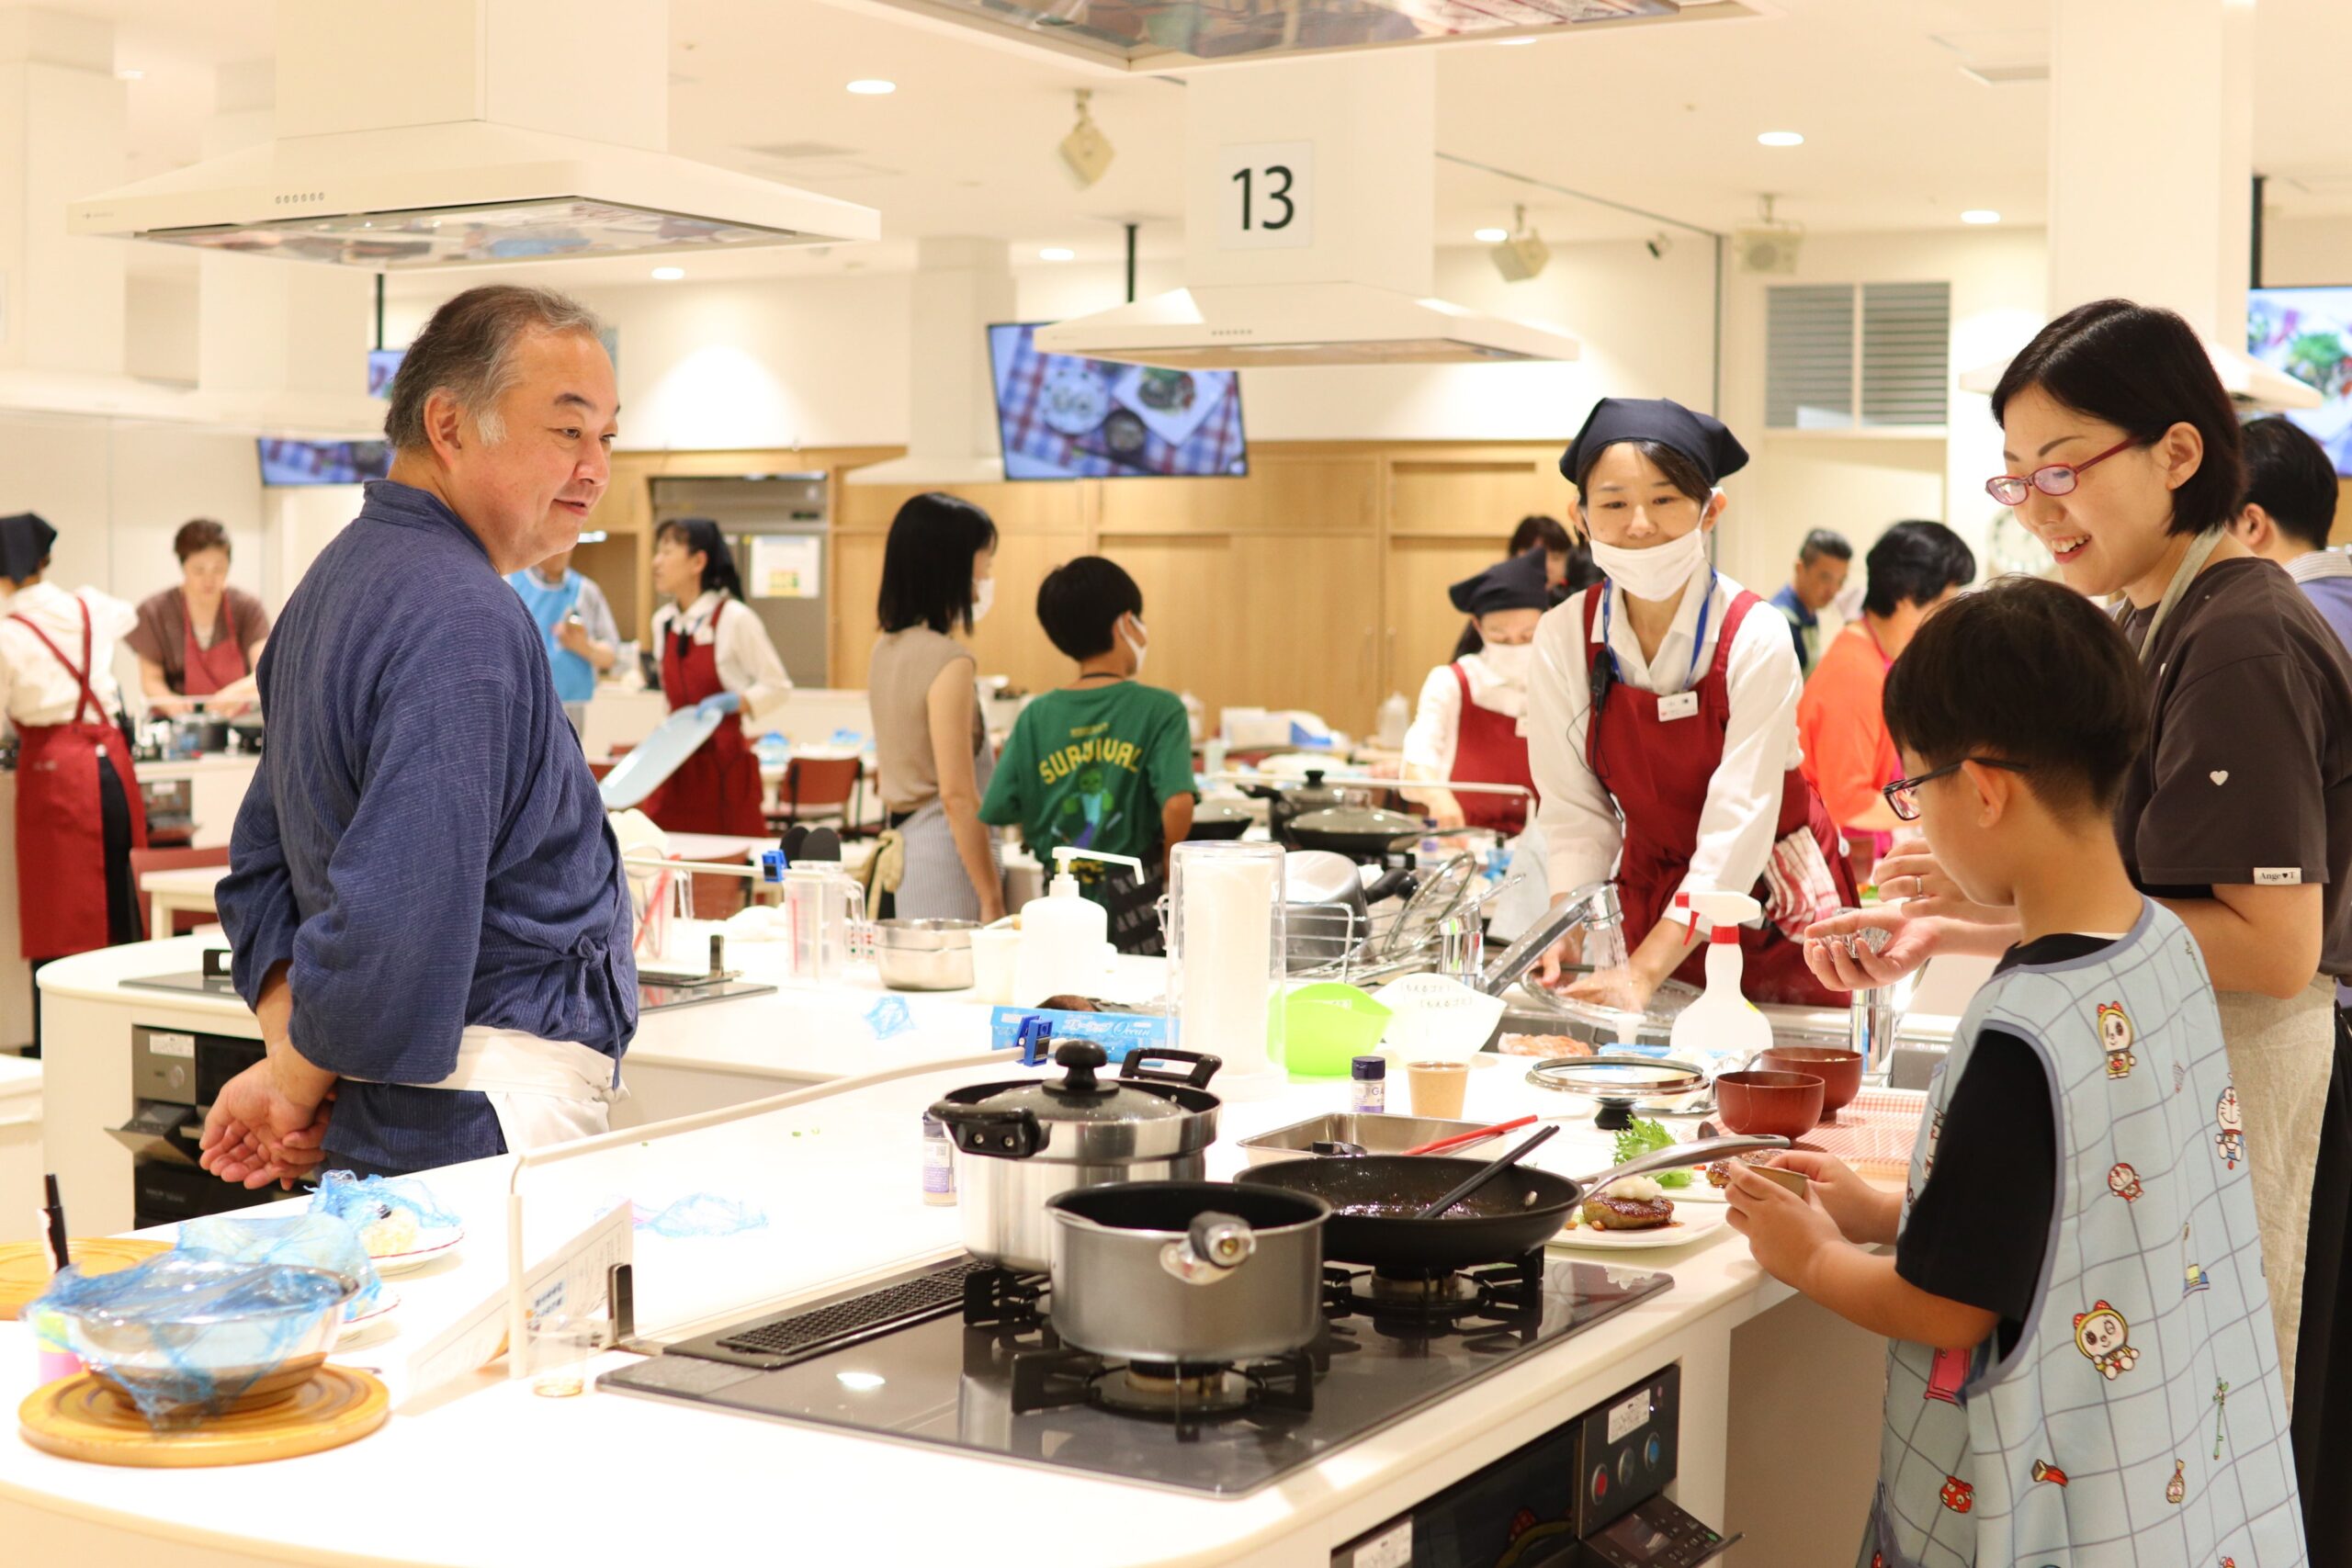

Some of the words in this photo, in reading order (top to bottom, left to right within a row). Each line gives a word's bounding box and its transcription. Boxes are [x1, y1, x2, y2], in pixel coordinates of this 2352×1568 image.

[1232, 164, 1295, 231] 13
[1038, 738, 1142, 784] SURVIVAL
[1113, 1019, 1151, 1037] Ocean
